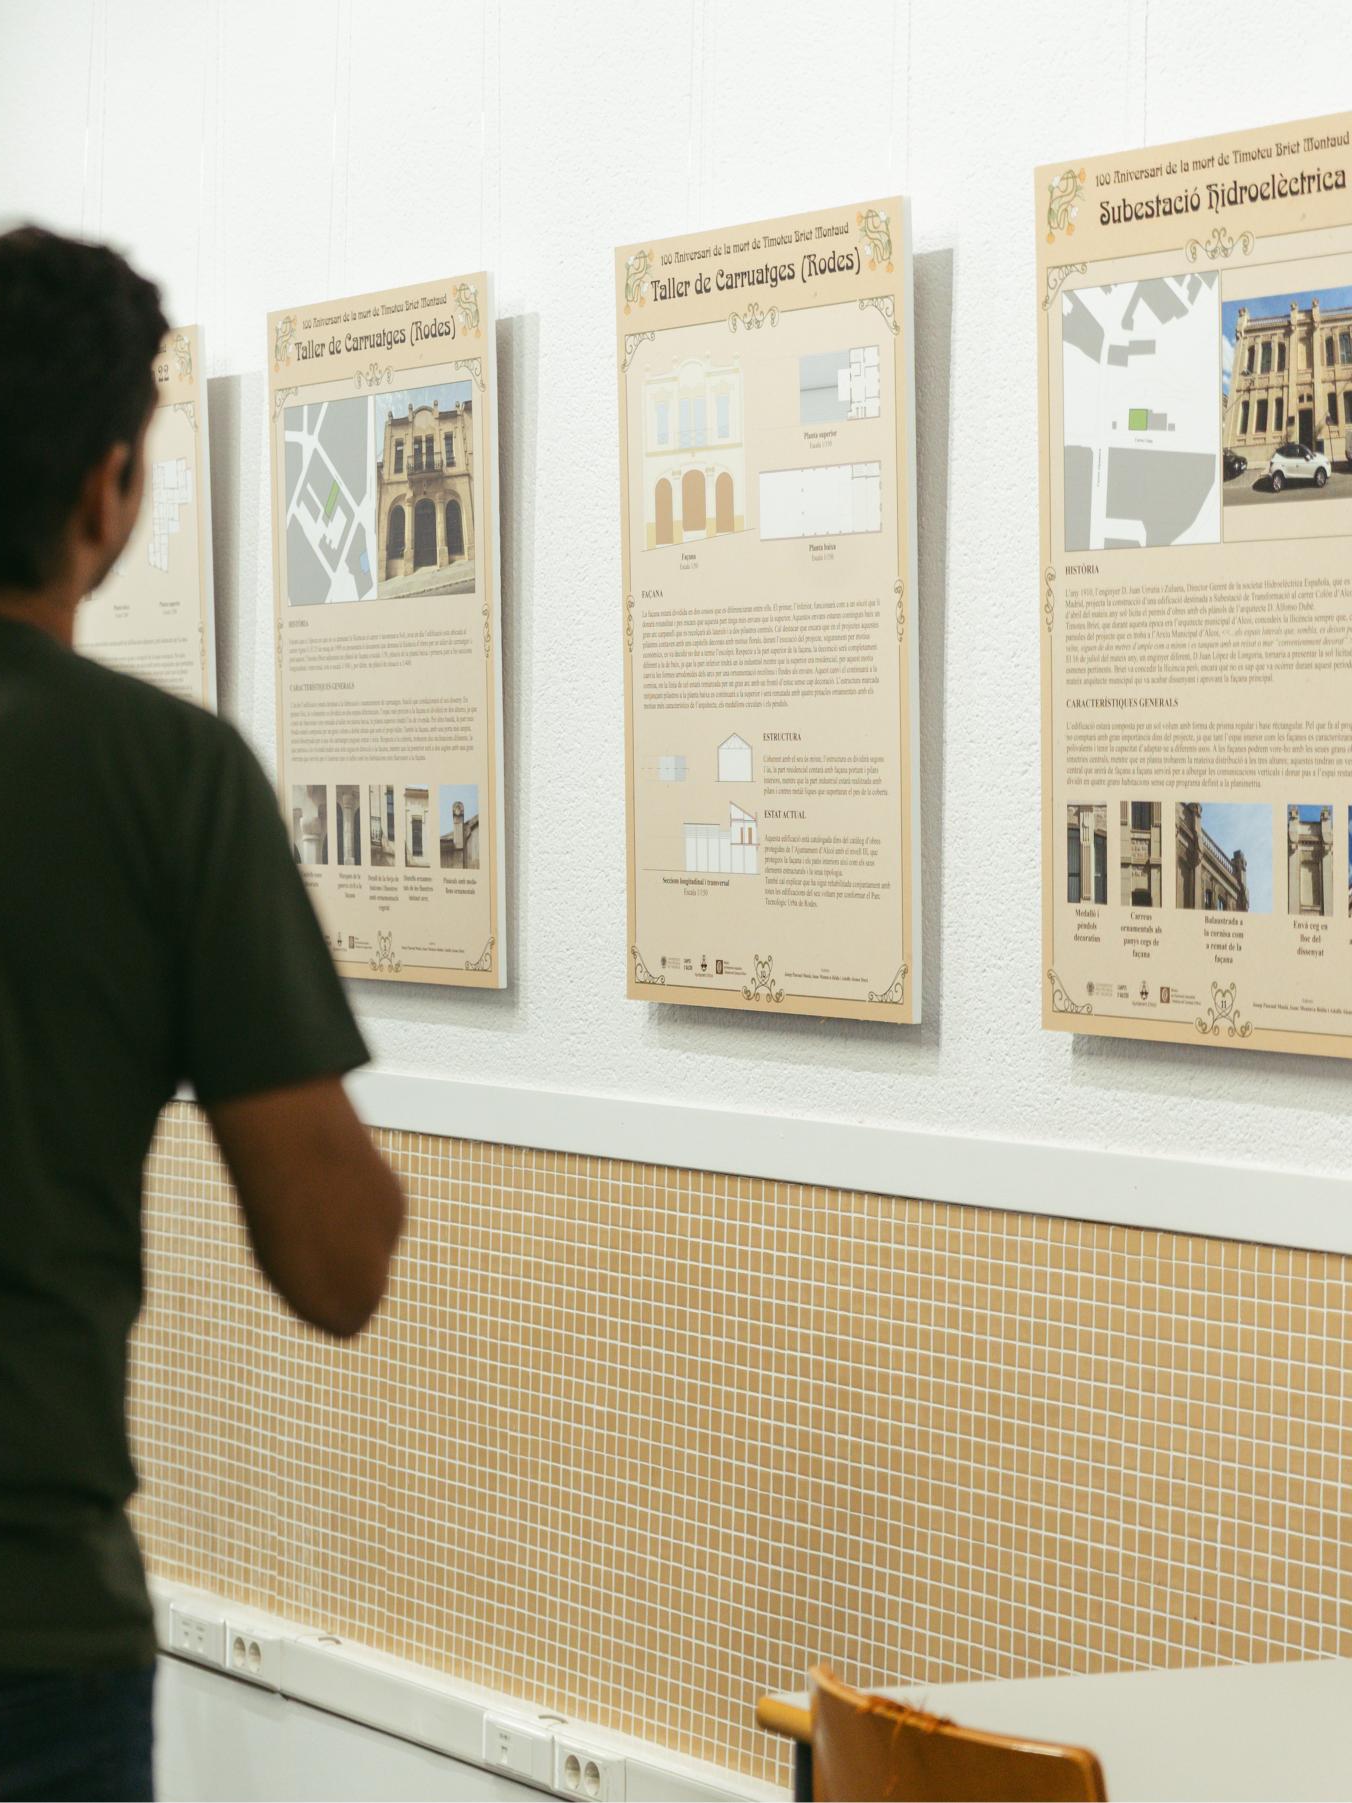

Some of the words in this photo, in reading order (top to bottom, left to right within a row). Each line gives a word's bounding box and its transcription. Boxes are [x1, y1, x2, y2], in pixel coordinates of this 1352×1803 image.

[1096, 173, 1111, 186] 100
[1114, 164, 1162, 183] Aniversari
[1166, 162, 1177, 175] de
[1181, 160, 1189, 173] la
[1193, 156, 1215, 171] mort
[1218, 153, 1229, 166] de
[1232, 148, 1272, 163] Timoteu
[1275, 141, 1300, 156] Briet
[1304, 133, 1349, 152] Montaud
[1100, 187, 1200, 225] Subestació
[1206, 168, 1346, 213] Hidroelèctrica
[661, 254, 672, 266] 100
[675, 247, 711, 263] Aniversari
[713, 245, 722, 256] de
[724, 244, 731, 255] la
[733, 241, 749, 253] mort
[752, 238, 761, 250] de
[763, 235, 792, 248] Timoteu
[794, 230, 812, 242] Briet
[815, 222, 848, 239] Montaud
[651, 277, 690, 302] Taller
[695, 273, 711, 294] de
[716, 263, 795, 291] Carruatges
[801, 247, 860, 283] (Rodes)
[295, 340, 325, 361] Taller
[329, 336, 341, 355] de
[345, 329, 406, 352] Carruatges
[411, 315, 455, 346] (Rodes)
[1066, 564, 1099, 575] HISTÒRIA
[642, 590, 663, 599] FAÇANA
[1066, 698, 1137, 709] CARACTERÍSTIQUES
[1139, 698, 1178, 707] GENERALS
[763, 733, 801, 741] ESTRUCTURA
[765, 810, 781, 818] ESTAT
[783, 811, 806, 819] ACTUAL
[1131, 912, 1152, 920] Carreus
[1205, 916, 1238, 925] Balaustrada
[1121, 925, 1153, 933] ornamentals
[1310, 923, 1319, 932] ceg
[1074, 933, 1100, 942] decoratius
[1211, 929, 1230, 938] cornisa
[1124, 938, 1139, 947] panys
[1140, 939, 1151, 947] cegs
[1300, 934, 1310, 943] lloc
[1312, 935, 1321, 943] del
[1133, 949, 1150, 958] façana
[1297, 947, 1324, 957] dissenyat
[1215, 954, 1233, 964] façana
[1221, 1000, 1227, 1009] 11
